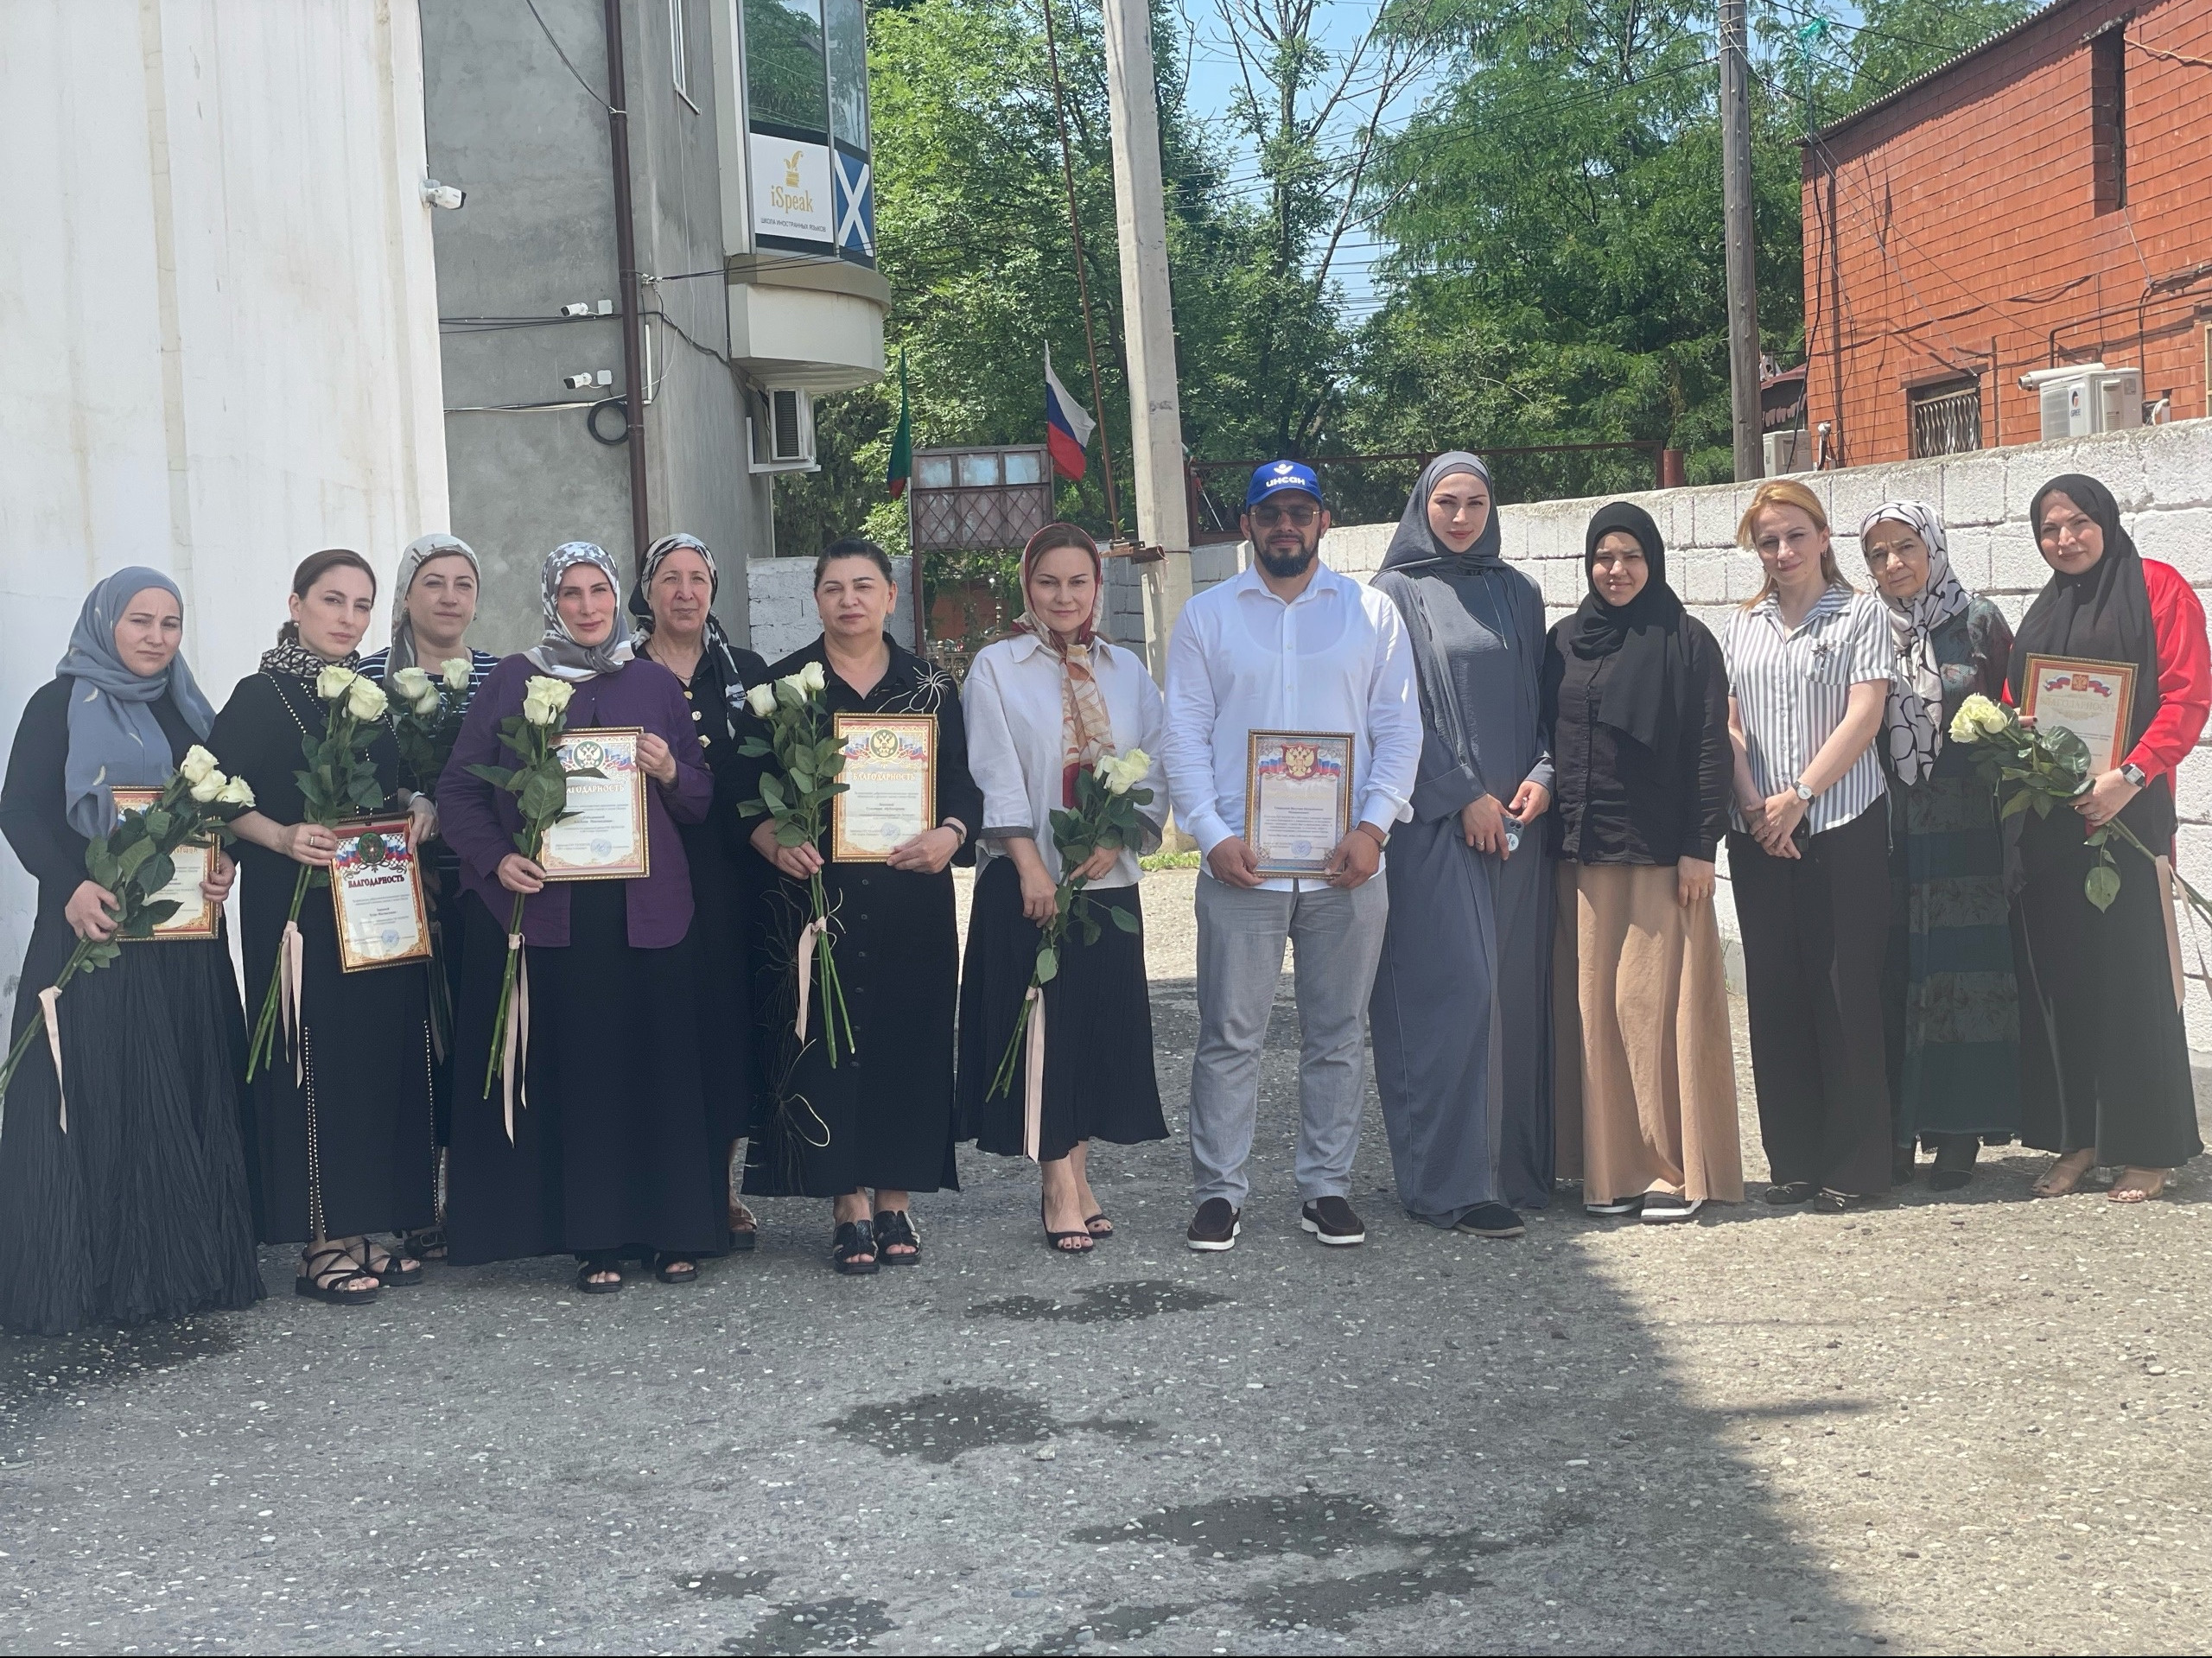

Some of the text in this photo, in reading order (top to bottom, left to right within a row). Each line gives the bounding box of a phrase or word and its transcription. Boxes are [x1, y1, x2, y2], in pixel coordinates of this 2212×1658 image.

[771, 185, 814, 213] iSpeak
[776, 219, 808, 230] ИНОСТРАННЫХ
[809, 224, 827, 232] ЯЗЫКОВ
[853, 772, 916, 781] БЛАГОДАРНОСТЬ
[566, 785, 625, 794] АГОДАРНОСТЬ
